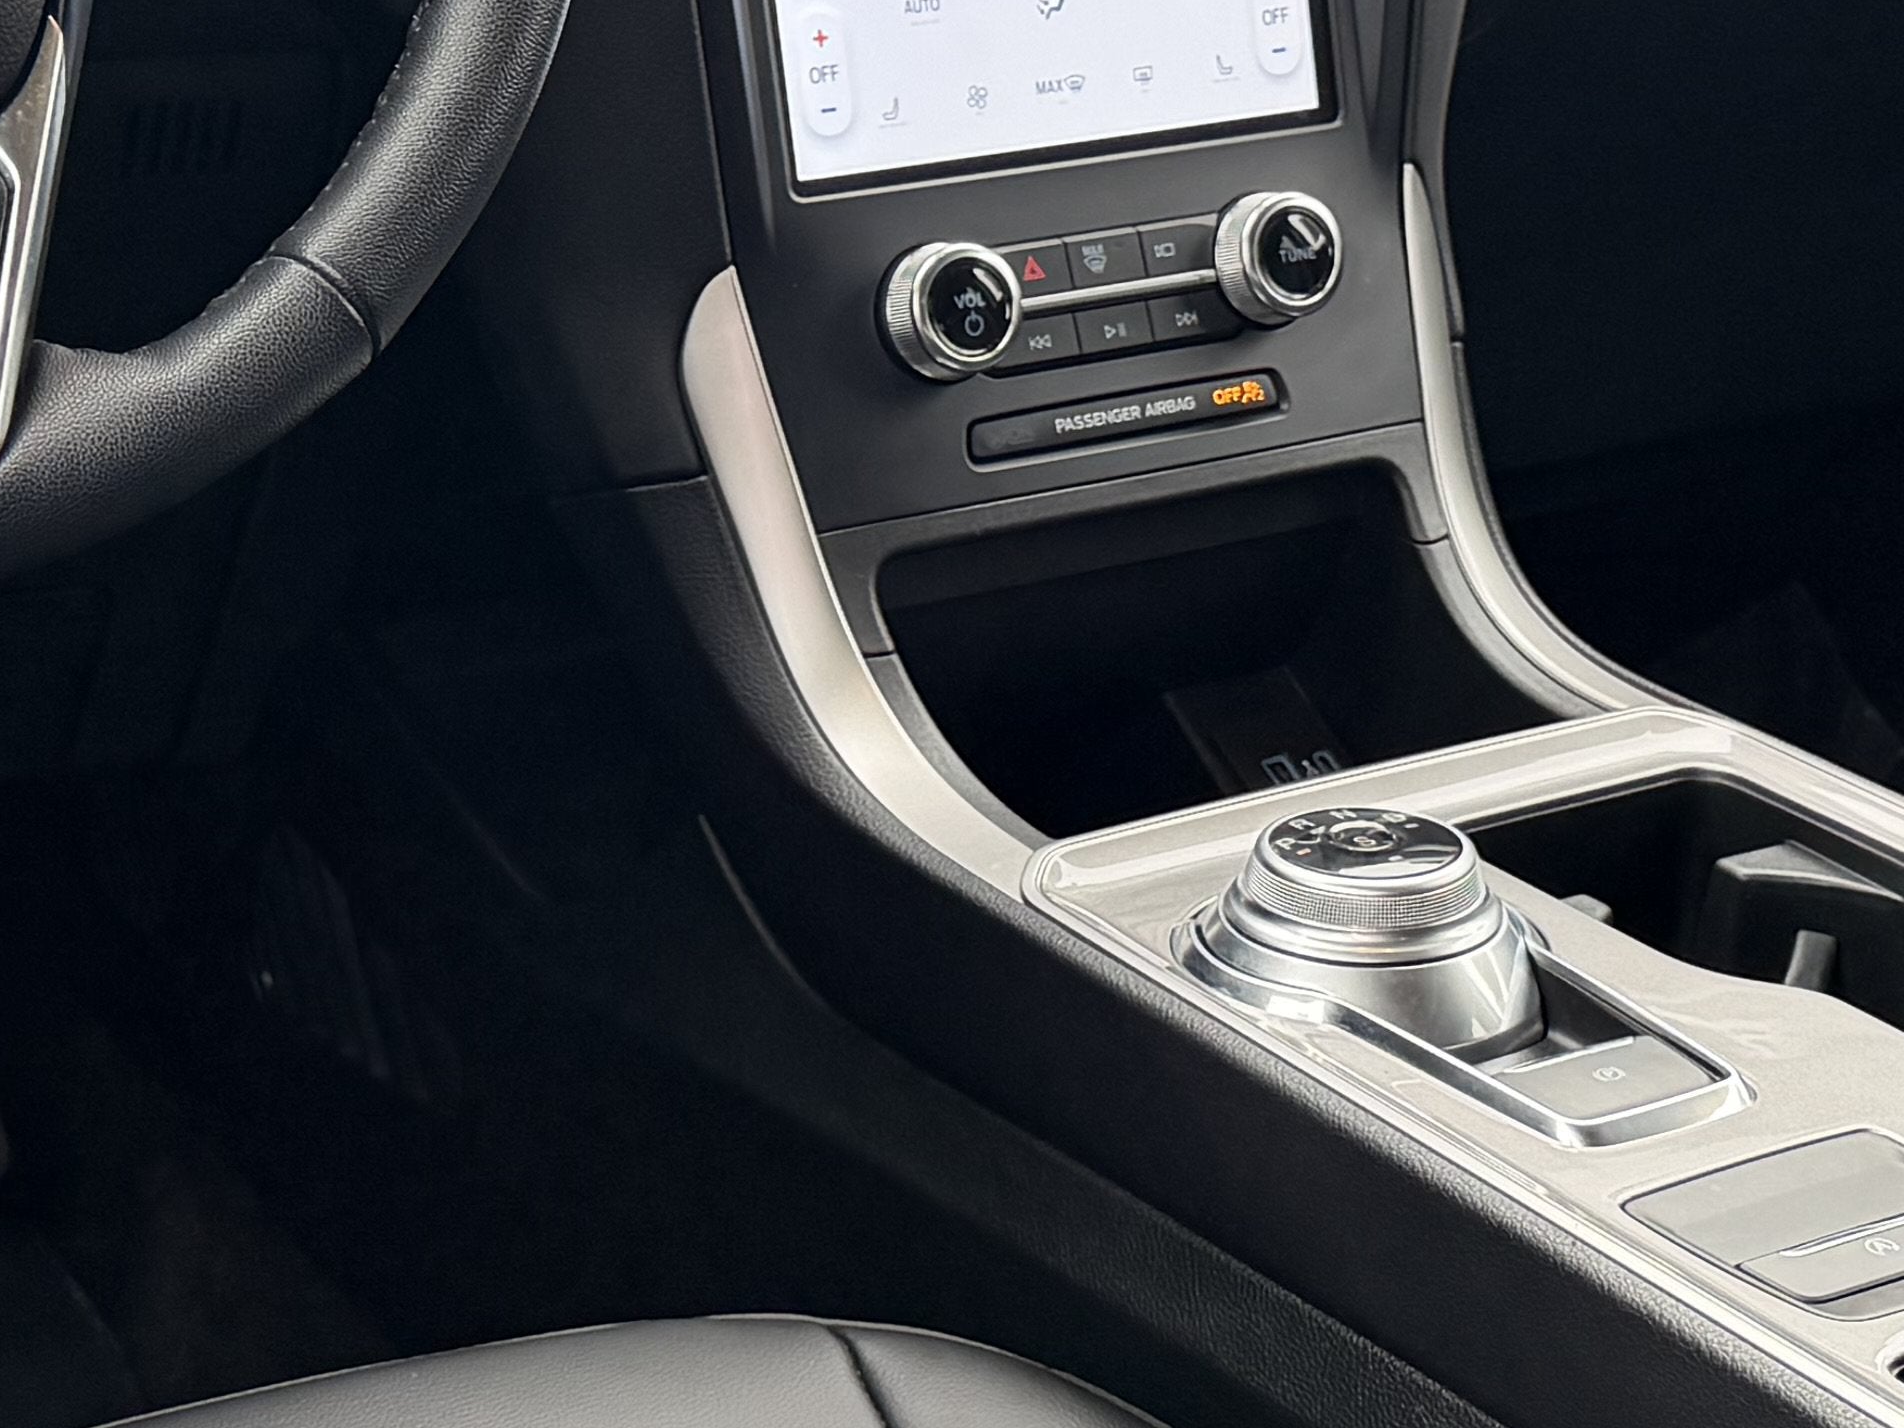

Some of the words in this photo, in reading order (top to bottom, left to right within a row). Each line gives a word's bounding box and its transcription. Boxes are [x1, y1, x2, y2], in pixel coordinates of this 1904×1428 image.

[1262, 7, 1290, 26] OFF
[809, 65, 839, 85] OFF
[1035, 79, 1064, 96] MAX
[1277, 247, 1317, 264] TUNE
[954, 292, 986, 310] VOL
[1054, 403, 1142, 434] PASSENGER
[1144, 396, 1196, 419] AIRBAG
[1212, 386, 1242, 406] OFF
[1276, 838, 1296, 851] P
